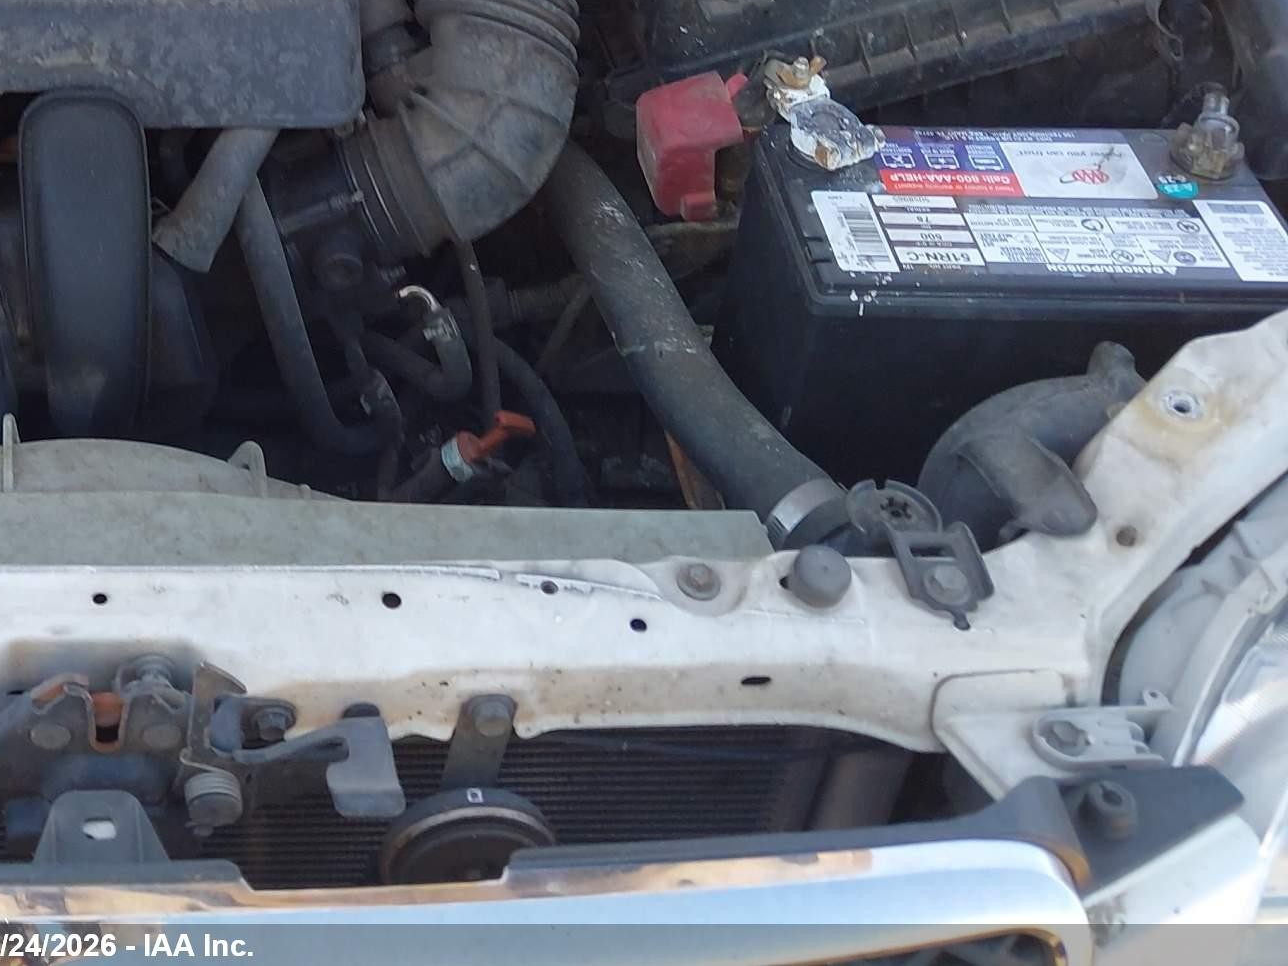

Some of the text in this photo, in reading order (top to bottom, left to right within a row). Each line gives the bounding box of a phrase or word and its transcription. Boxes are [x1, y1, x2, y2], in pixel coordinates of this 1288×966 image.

[1047, 149, 1065, 157] can
[1067, 149, 1088, 158] you
[889, 172, 980, 184] 800-AAA-HELP
